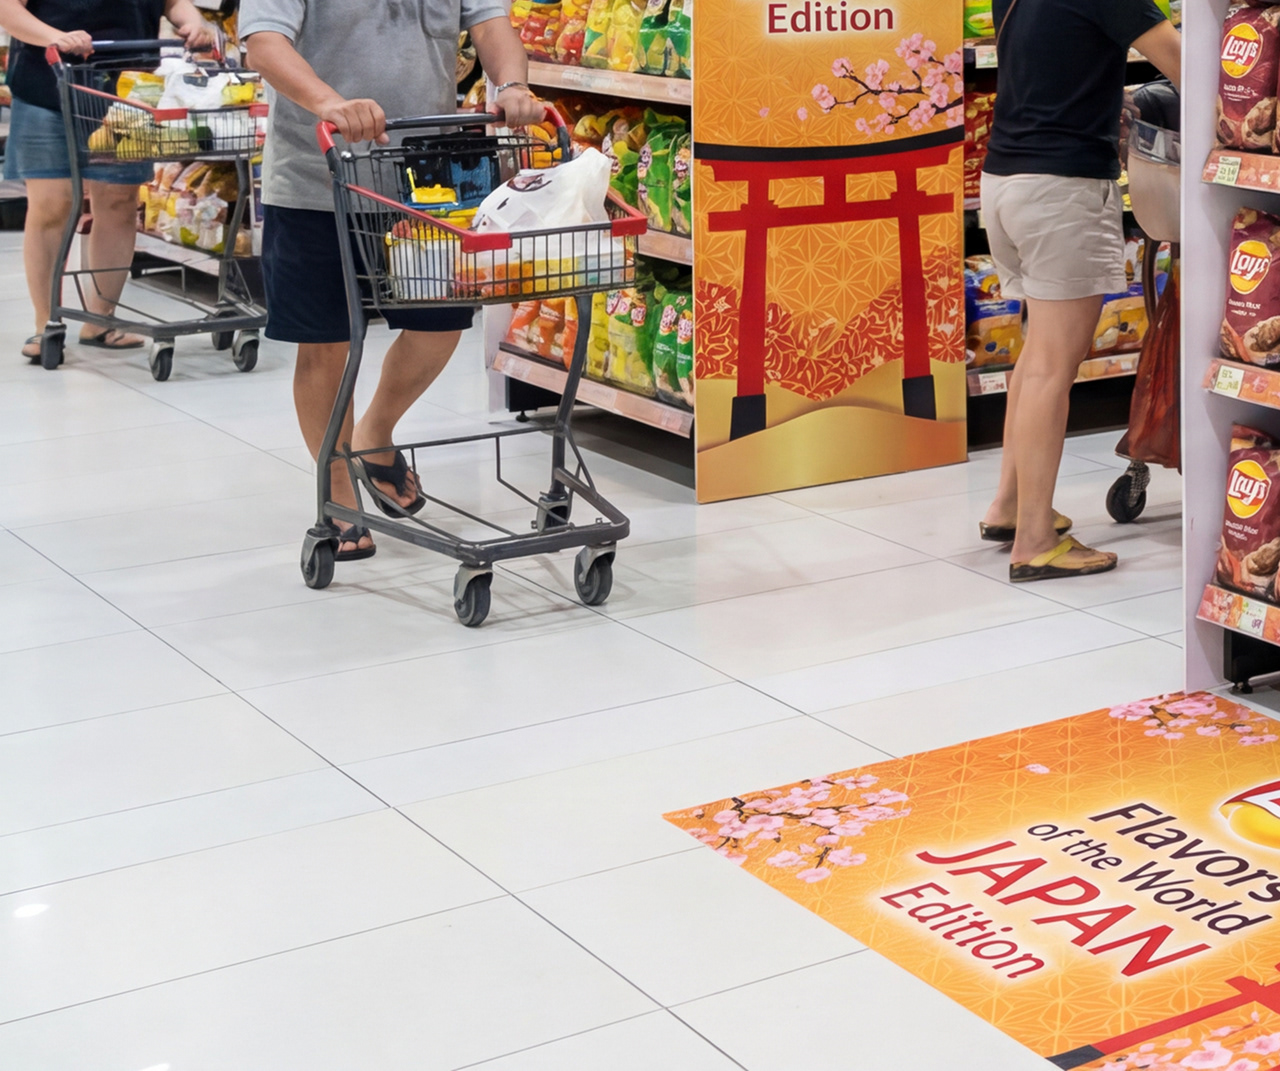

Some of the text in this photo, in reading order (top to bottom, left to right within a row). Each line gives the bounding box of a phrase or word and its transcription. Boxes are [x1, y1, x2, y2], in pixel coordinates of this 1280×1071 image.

[768, 1, 893, 33] Edition
[880, 882, 1046, 979] Edition
[916, 839, 1213, 978] JAPAN
[1026, 823, 1274, 936] of the World
